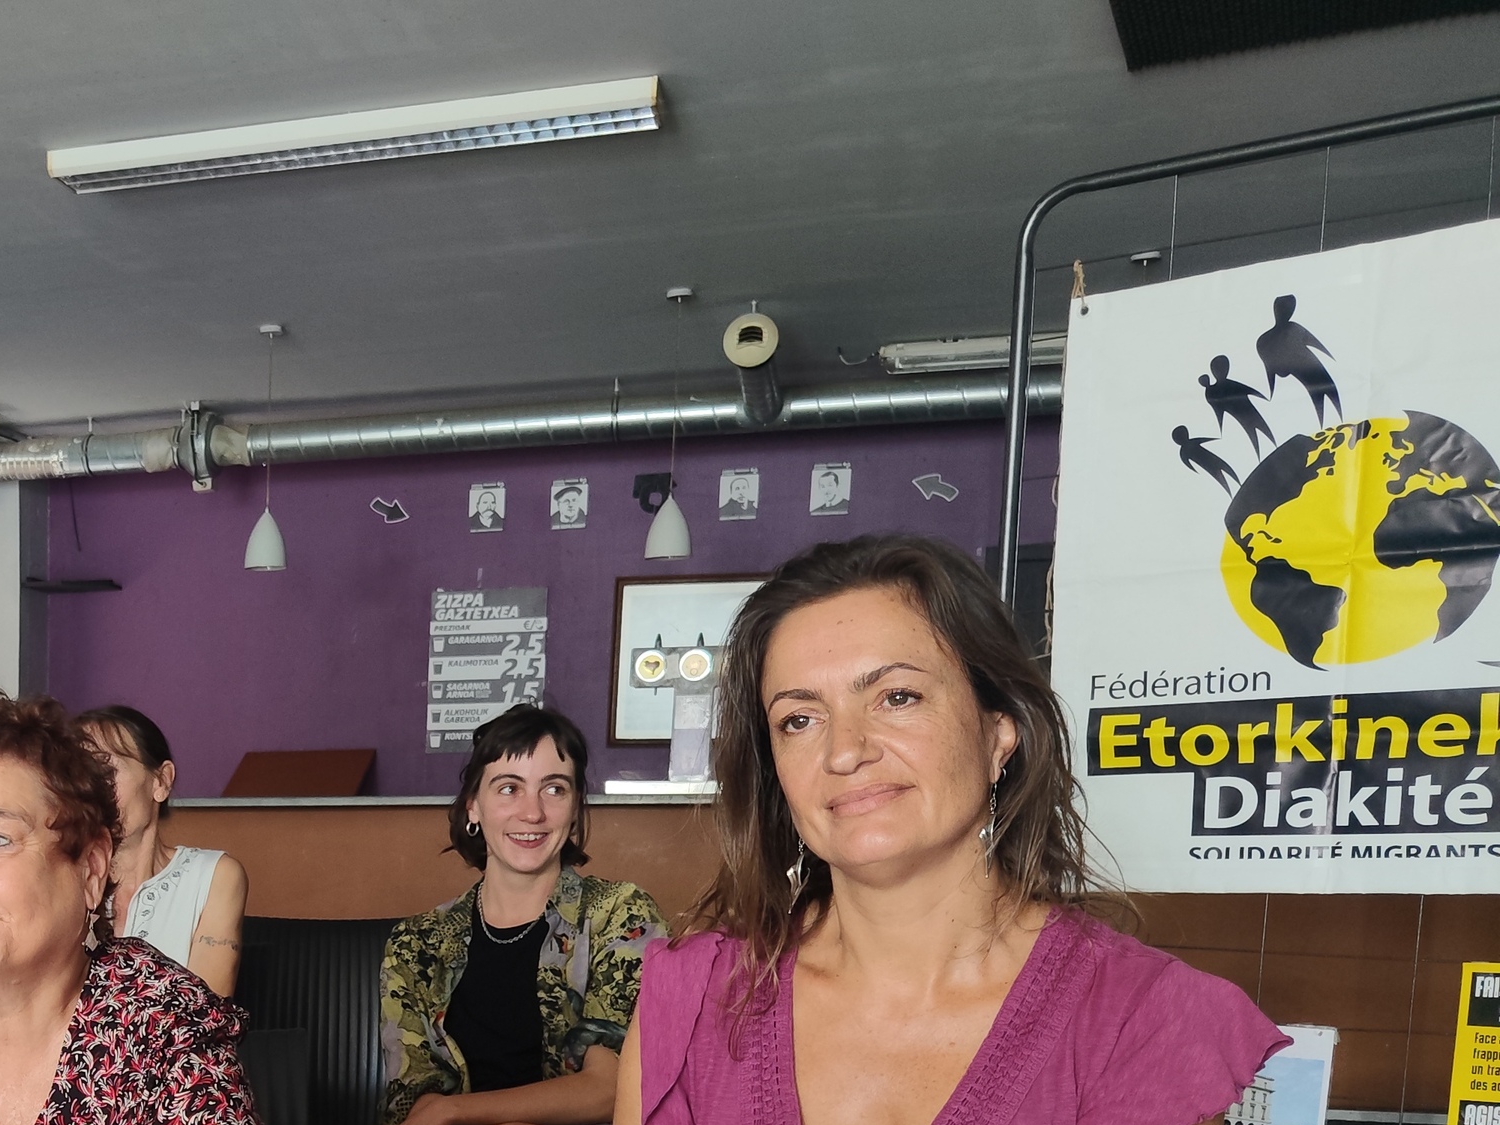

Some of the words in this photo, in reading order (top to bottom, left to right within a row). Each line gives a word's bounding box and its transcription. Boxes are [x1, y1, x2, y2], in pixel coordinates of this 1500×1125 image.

[435, 593, 484, 608] ZIZPA
[435, 606, 518, 620] GAZTETXEA
[448, 634, 504, 644] GARAGARNOA
[502, 634, 544, 656] 2,5
[448, 658, 499, 668] KALIMOTXOA
[500, 658, 542, 679] 2,5
[446, 682, 490, 691] SAGARNOA
[1090, 666, 1272, 700] Fédération
[446, 690, 475, 698] ARNOA
[1204, 766, 1492, 829] Diakité
[1474, 1032, 1496, 1044] Face
[1472, 1066, 1483, 1075] un
[1470, 1080, 1488, 1090] des
